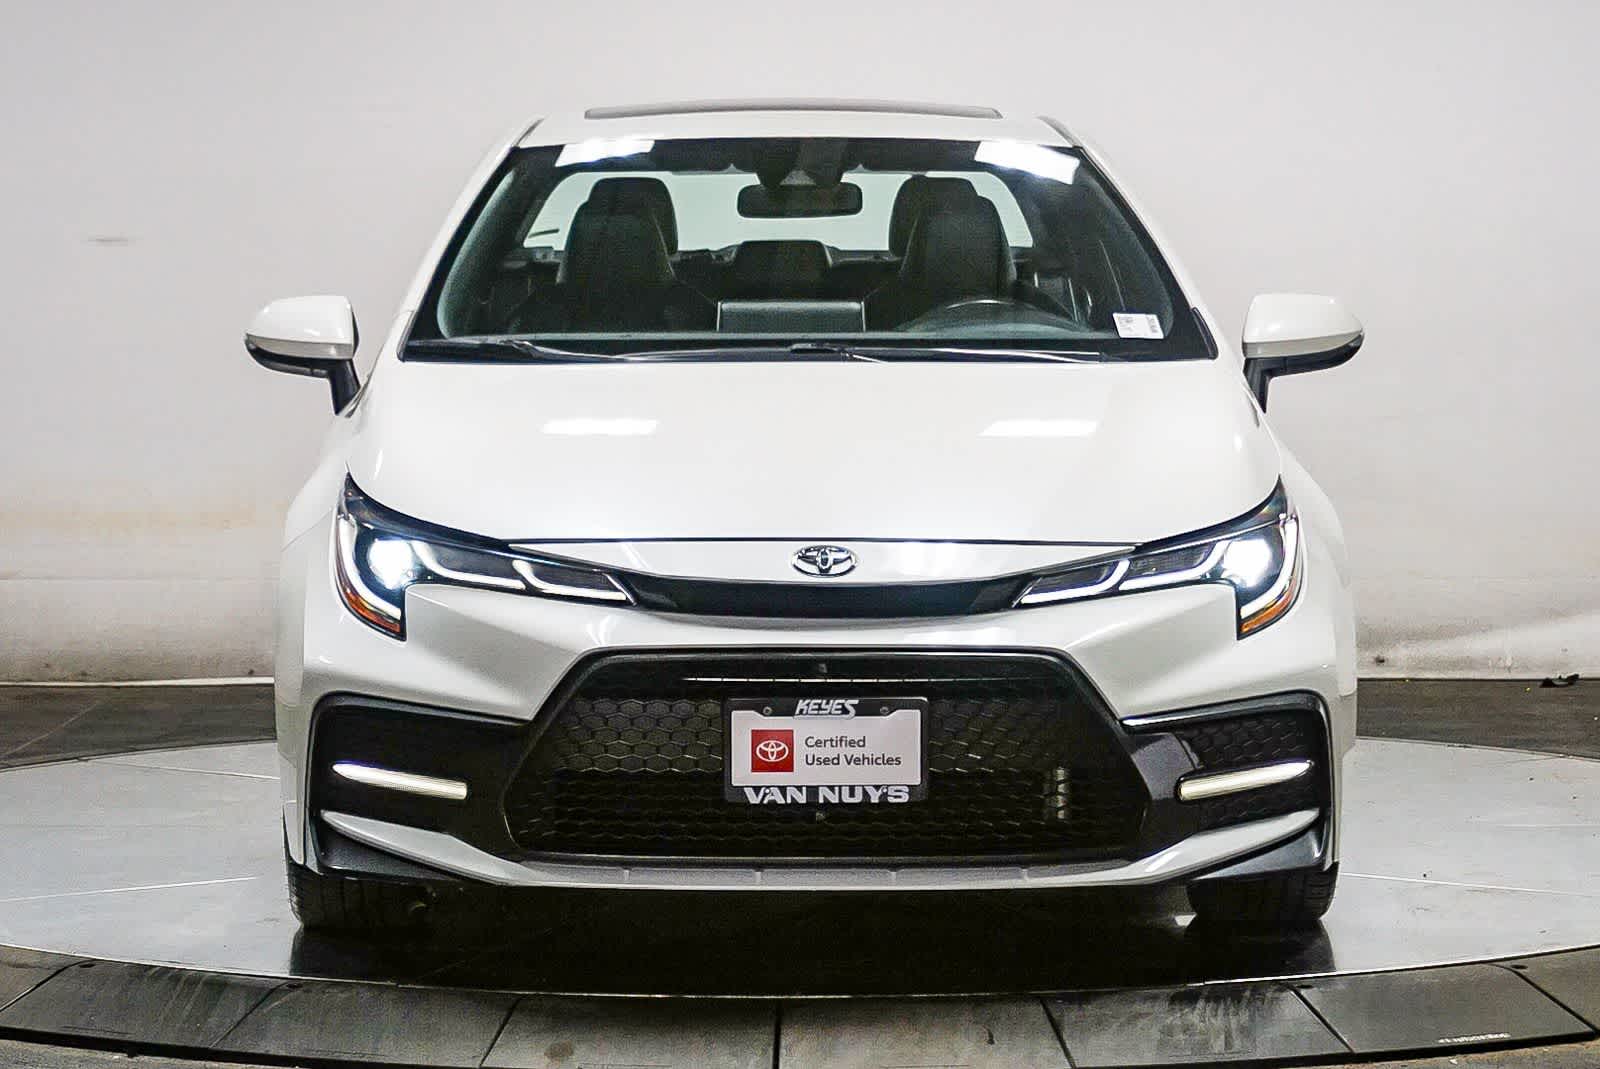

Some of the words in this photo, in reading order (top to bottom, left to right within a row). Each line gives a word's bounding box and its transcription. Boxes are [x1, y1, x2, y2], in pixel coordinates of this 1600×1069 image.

[794, 699, 859, 718] KEYES
[804, 735, 866, 748] Certified
[805, 754, 840, 766] Used
[844, 754, 902, 766] Vehicles
[743, 786, 806, 804] VAN
[818, 785, 910, 804] NUYS
